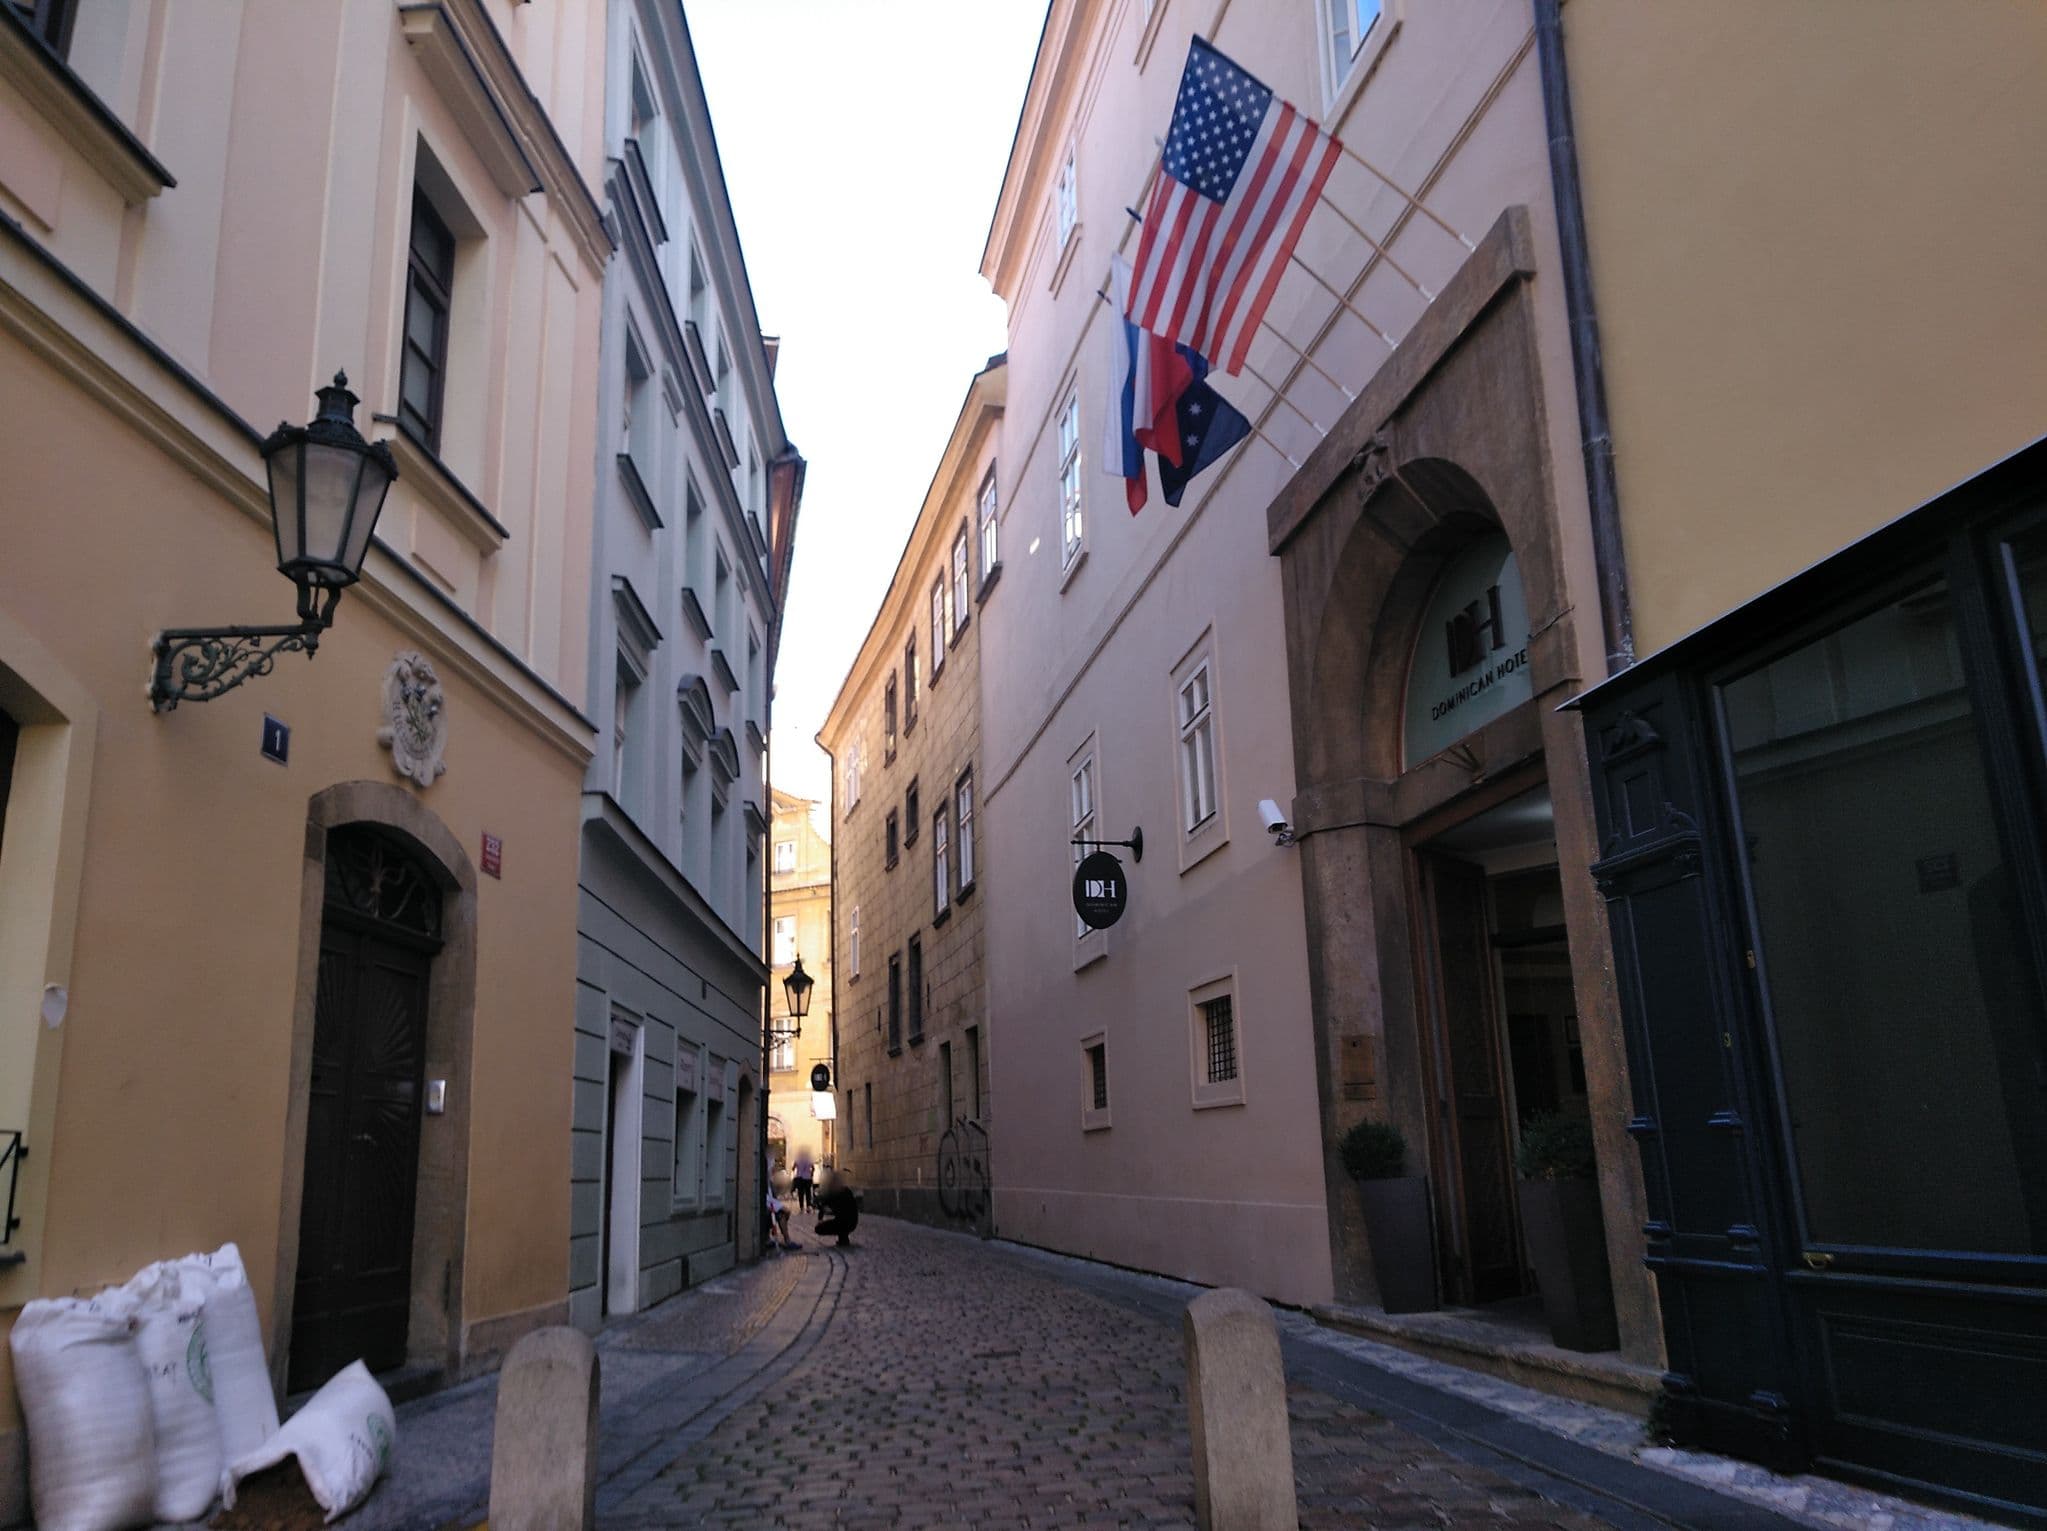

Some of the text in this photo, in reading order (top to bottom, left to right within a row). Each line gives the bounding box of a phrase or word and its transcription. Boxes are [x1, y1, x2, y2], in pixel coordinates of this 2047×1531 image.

[1431, 649, 1528, 721] DOMINICAN HOTE
[275, 729, 281, 751] 1
[1085, 879, 1117, 898] DH
